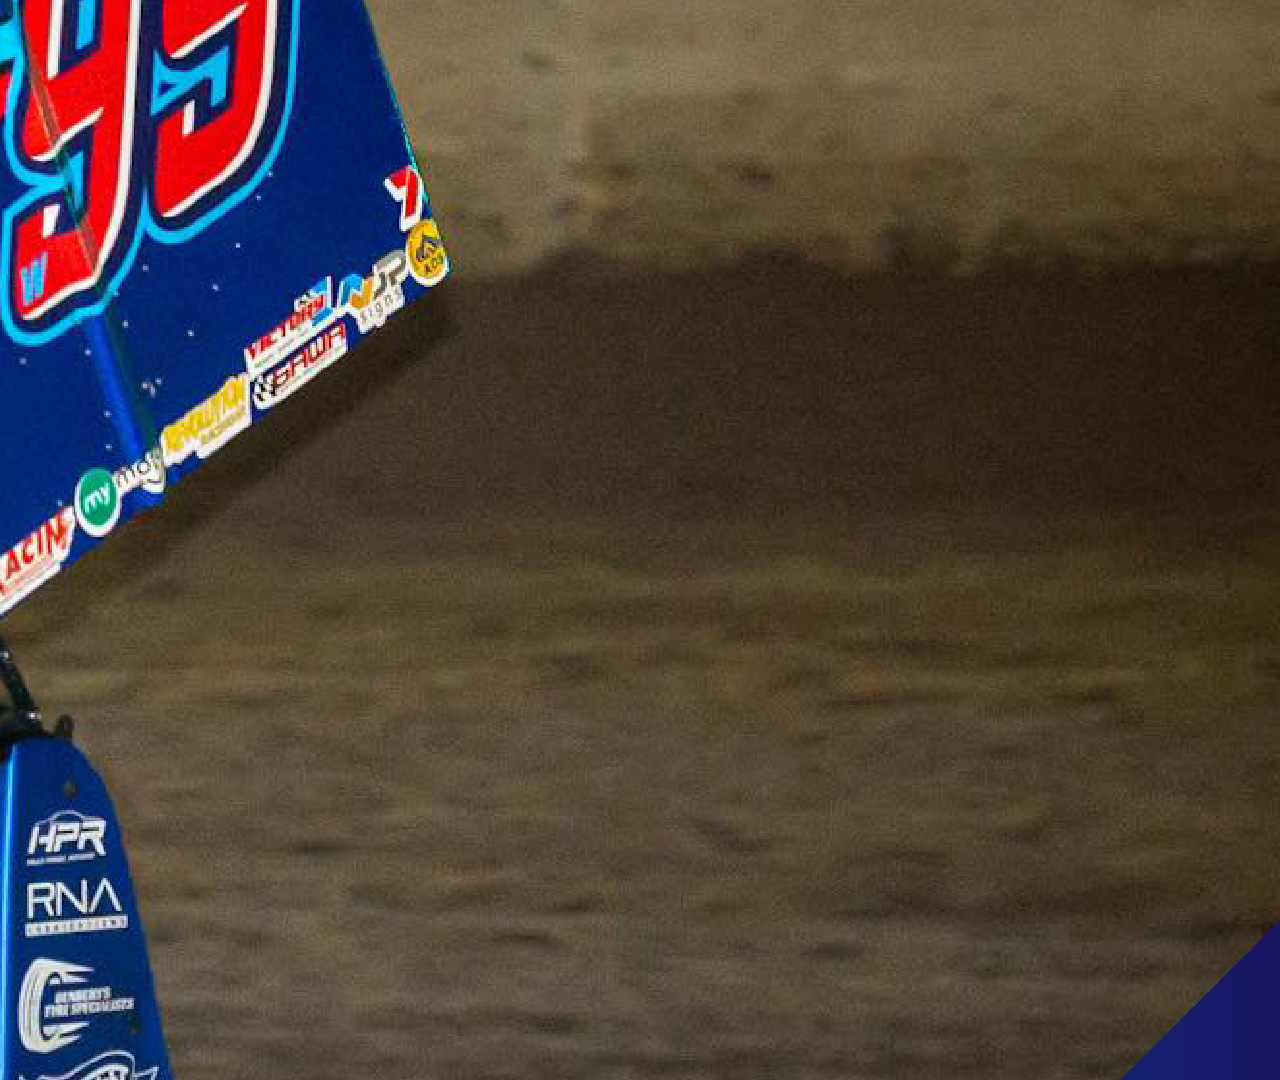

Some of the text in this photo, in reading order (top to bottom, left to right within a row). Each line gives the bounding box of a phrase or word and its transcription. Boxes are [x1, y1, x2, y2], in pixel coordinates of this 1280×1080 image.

[83, 481, 111, 514] my
[27, 816, 107, 856] HPR
[27, 878, 122, 918] RNA
